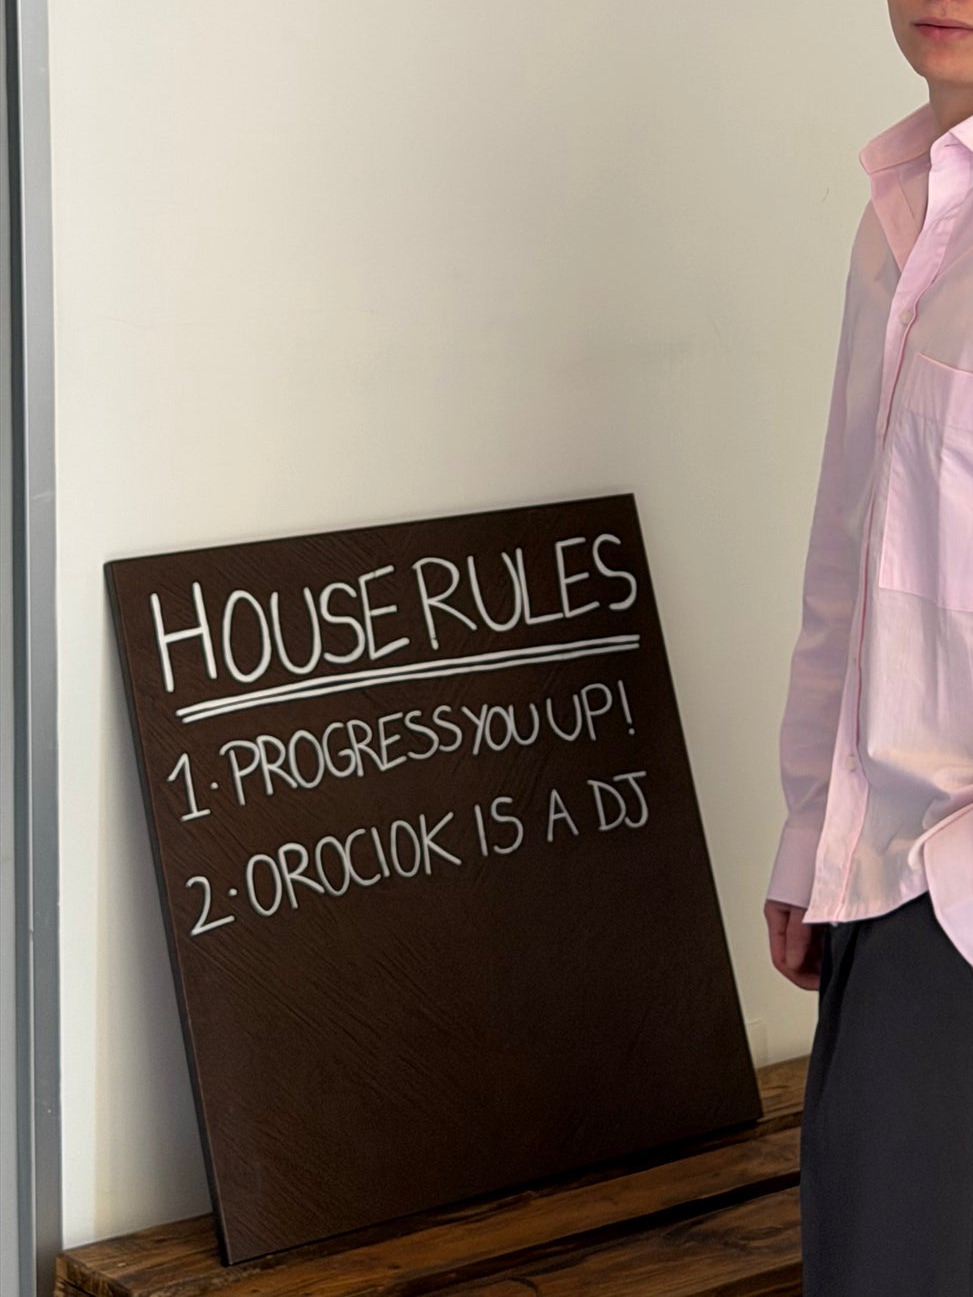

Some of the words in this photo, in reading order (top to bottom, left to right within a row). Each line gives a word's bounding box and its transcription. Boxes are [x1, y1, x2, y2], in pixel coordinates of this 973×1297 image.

[150, 565, 409, 692] HOUSE
[413, 533, 637, 650] RULES
[219, 705, 462, 806] PROGRESS
[462, 703, 540, 755] YOU
[546, 679, 636, 741] UP!
[246, 811, 462, 916] OROCIOK
[474, 796, 524, 856] IS
[546, 789, 579, 842] A
[586, 770, 648, 832] DJ
